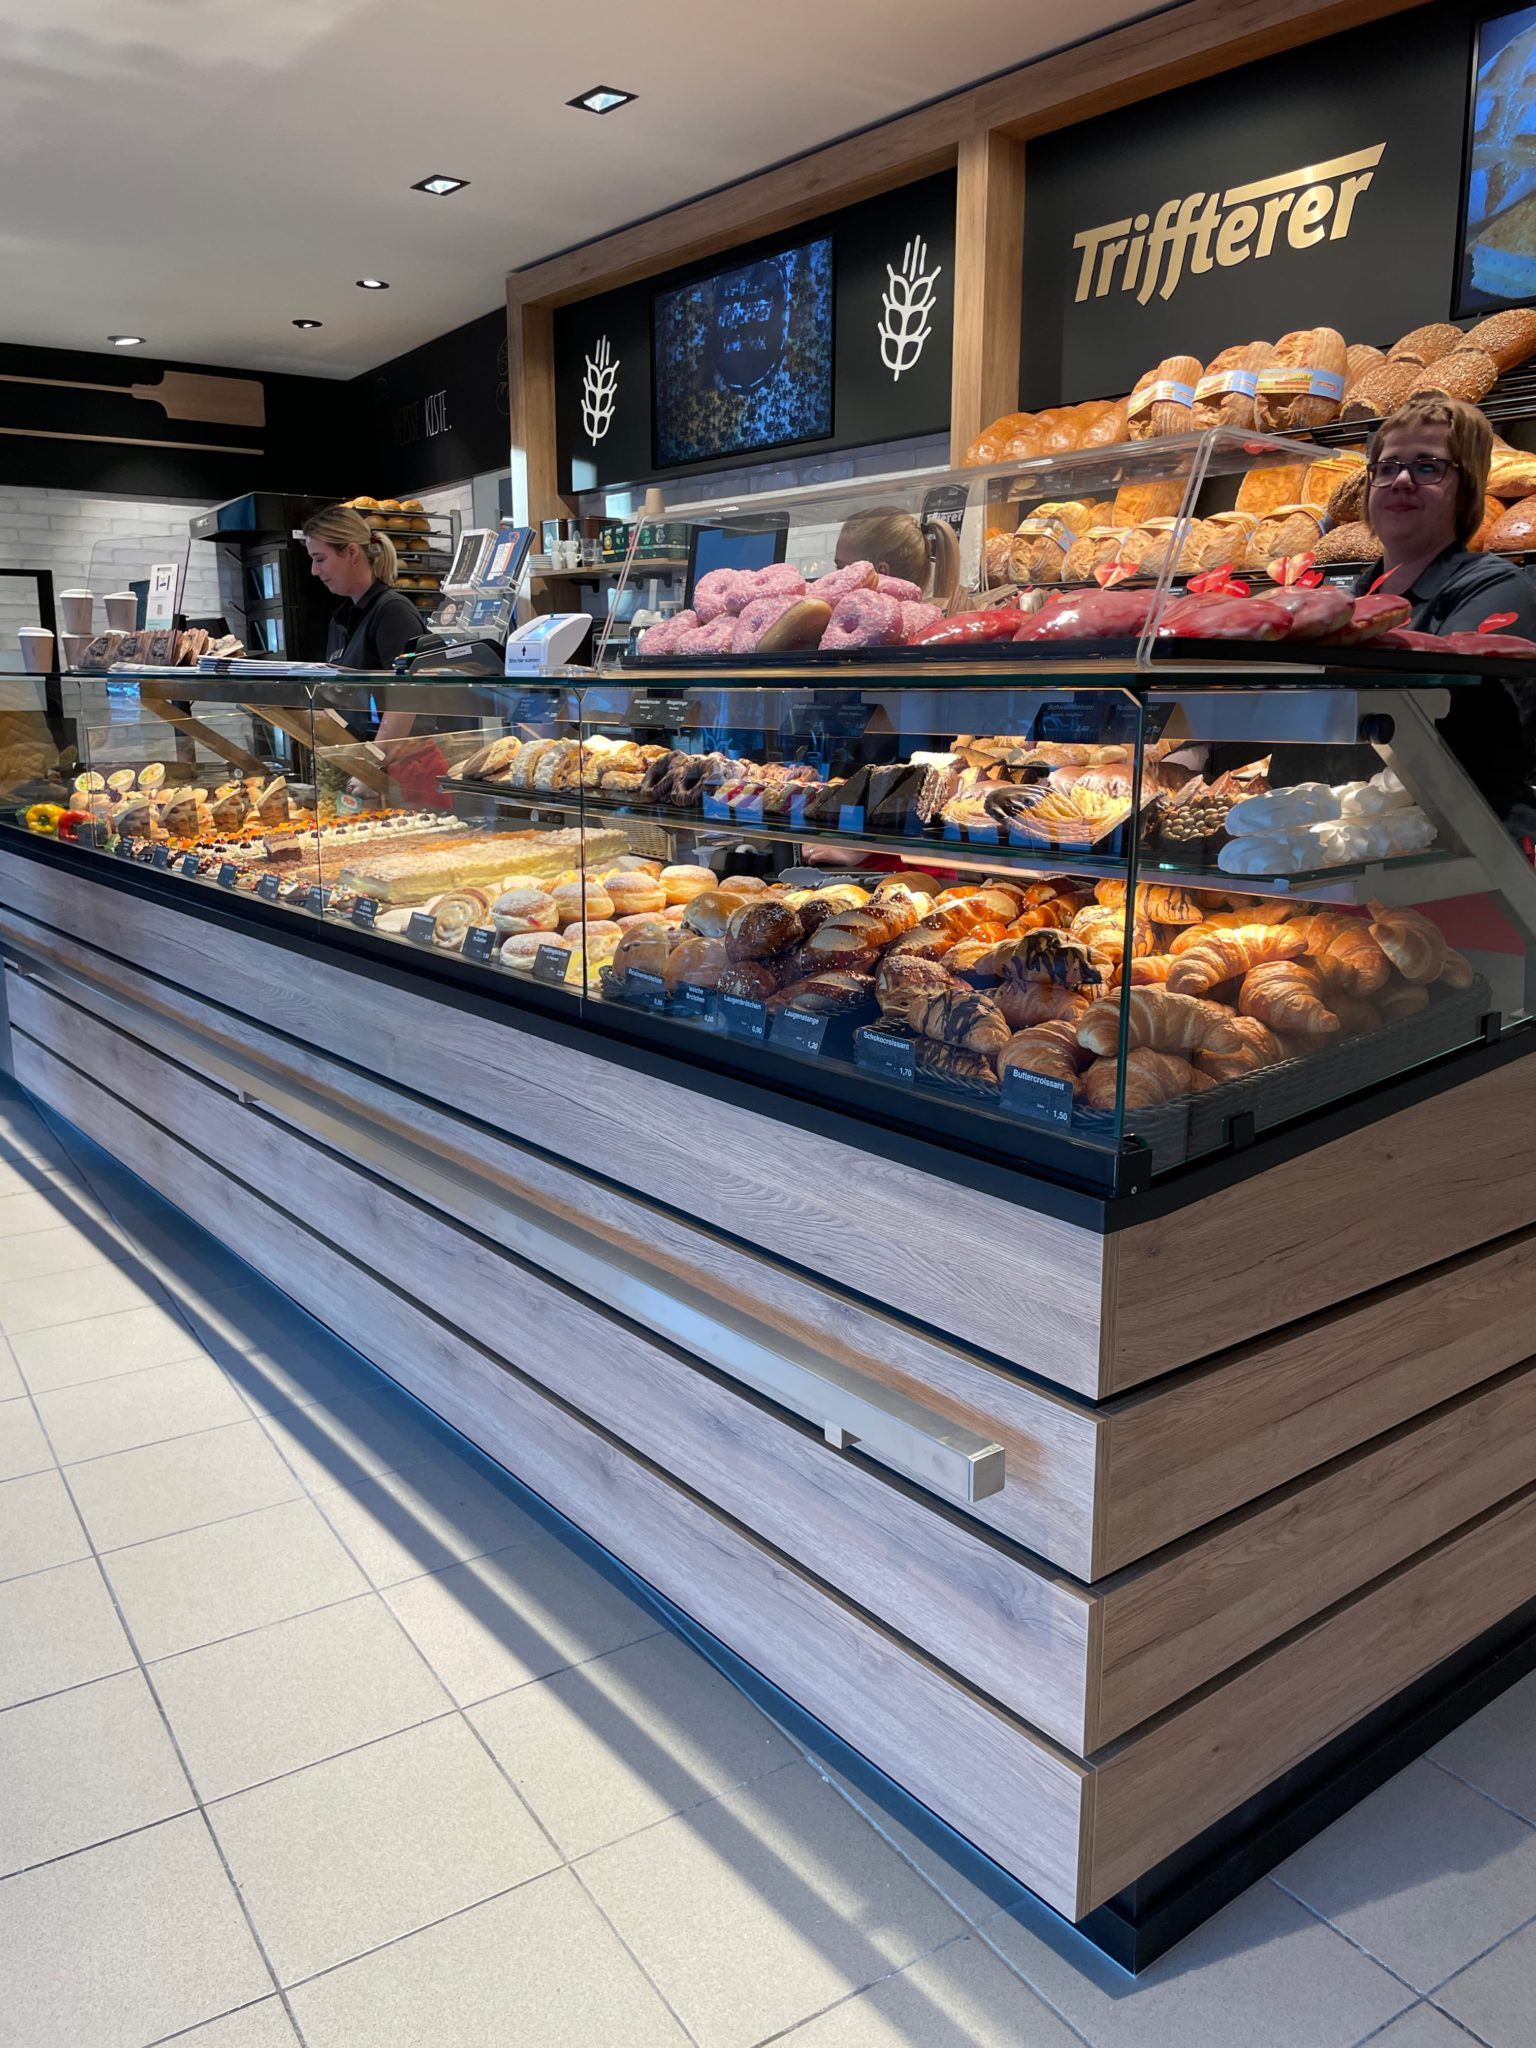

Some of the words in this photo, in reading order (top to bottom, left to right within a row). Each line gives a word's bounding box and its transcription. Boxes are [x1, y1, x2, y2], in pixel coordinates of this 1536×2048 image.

[1073, 142, 1386, 305] Triffterer
[424, 389, 453, 438] KISTE.
[685, 993, 705, 1004] Brötchen
[723, 993, 762, 1011] Laugenbrötchen
[784, 1008, 820, 1026] Laugenstange
[807, 1040, 819, 1050] 1,20
[863, 1031, 910, 1051] Schokocroissant
[900, 1067, 912, 1077] 1,70
[1013, 1069, 1065, 1092] Buttercroissant
[1053, 1110, 1068, 1121] 1,50
